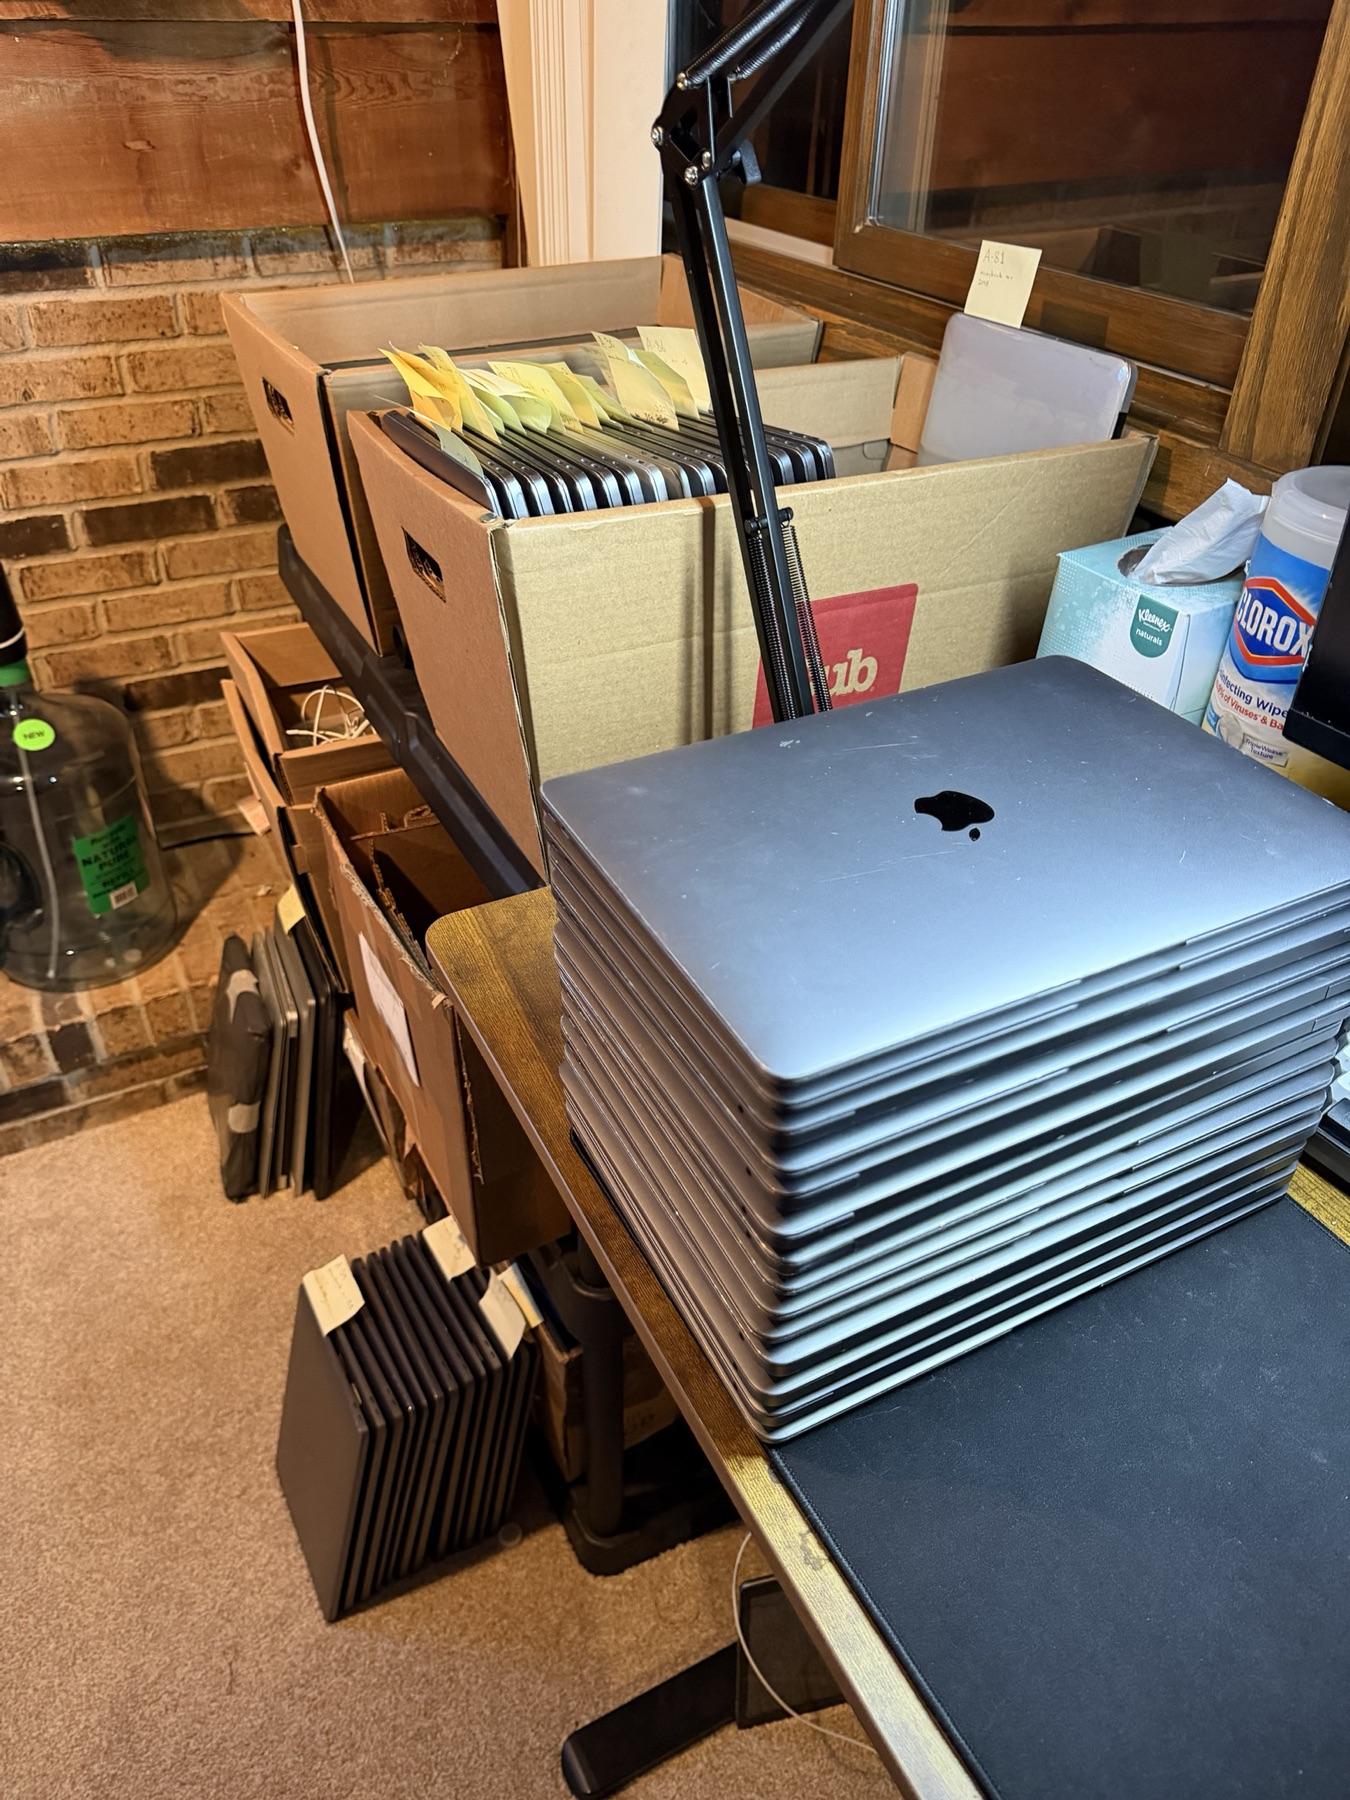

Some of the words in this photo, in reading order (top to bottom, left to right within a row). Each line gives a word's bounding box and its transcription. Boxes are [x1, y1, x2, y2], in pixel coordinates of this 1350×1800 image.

[1138, 608, 1171, 633] Kleenex
[1236, 586, 1315, 659] CLOROX
[1135, 628, 1163, 646] naturals
[1260, 714, 1268, 725] &
